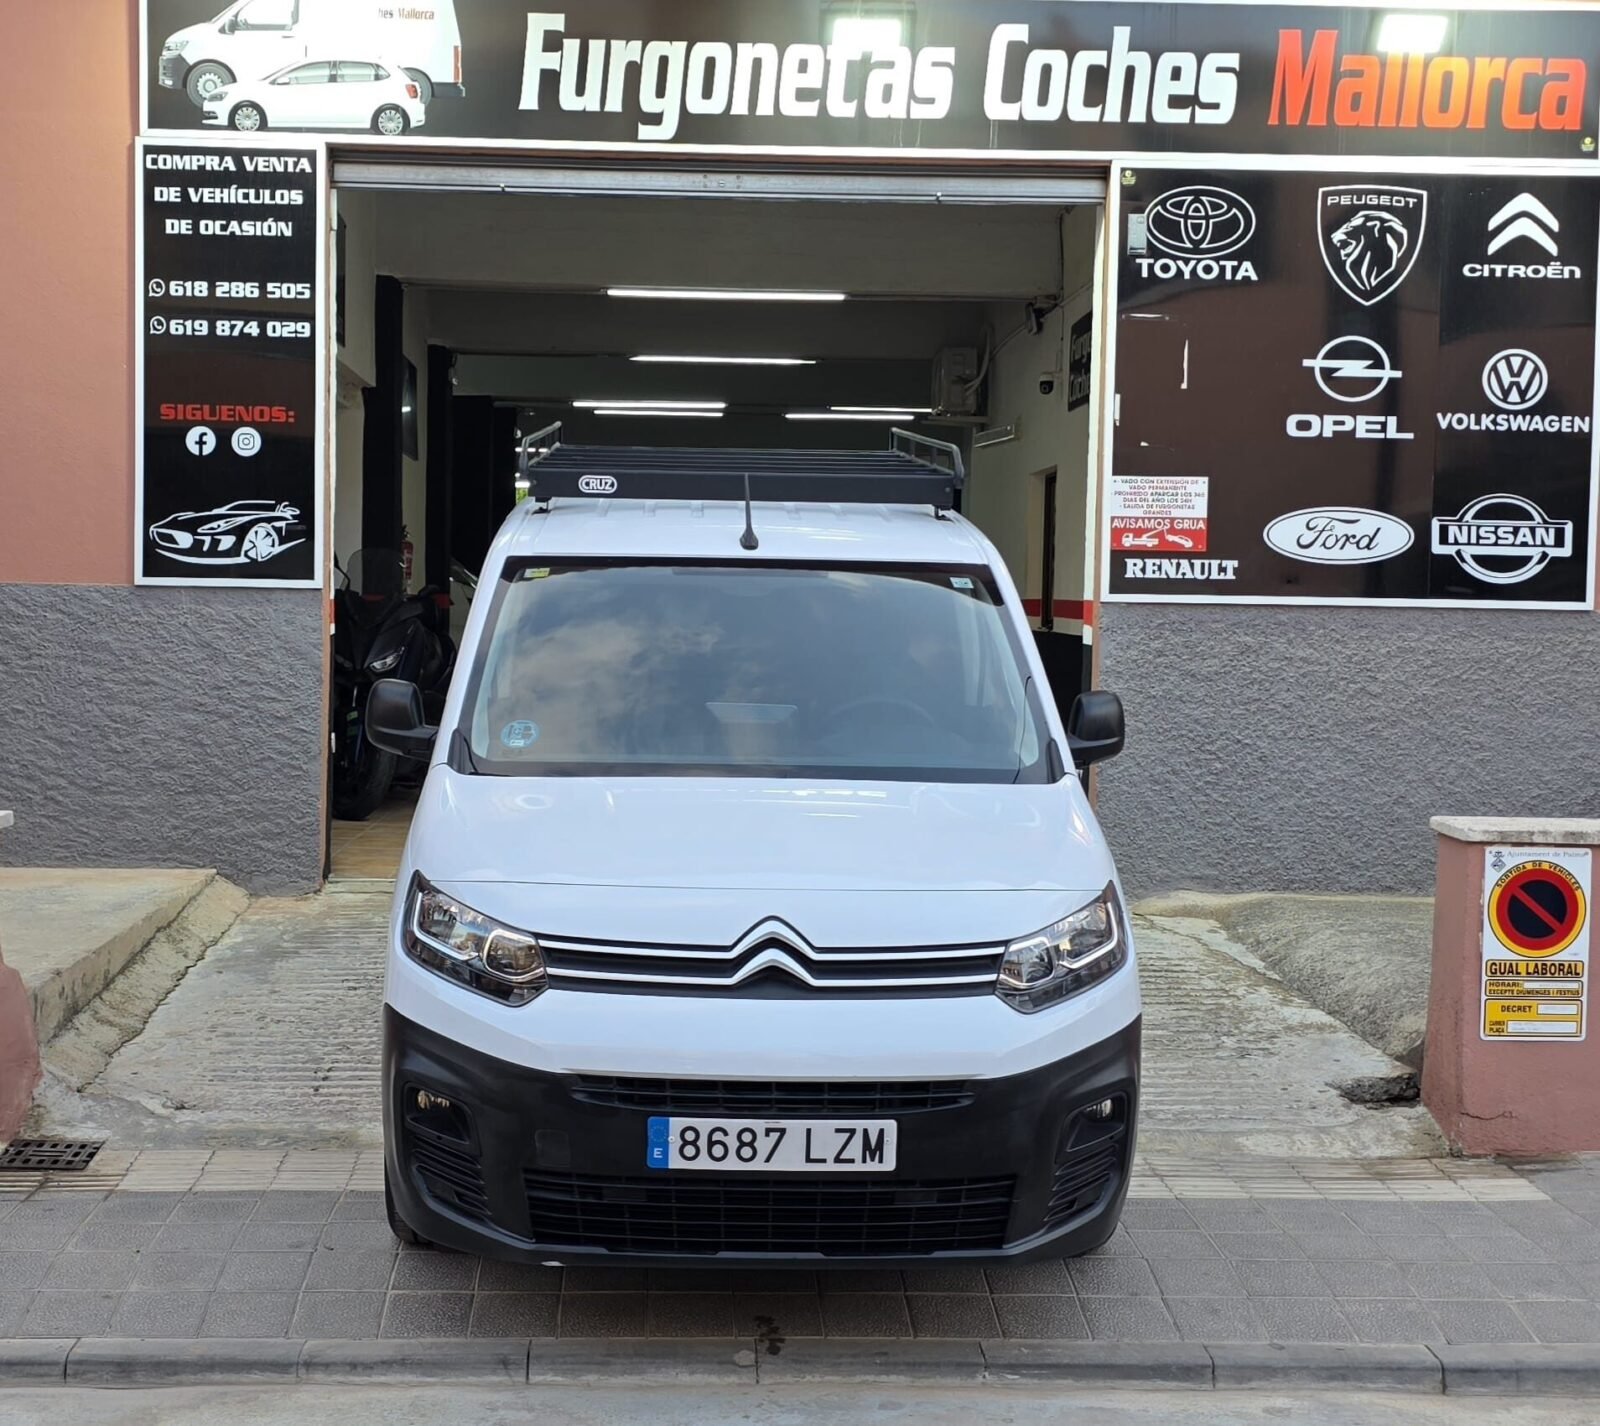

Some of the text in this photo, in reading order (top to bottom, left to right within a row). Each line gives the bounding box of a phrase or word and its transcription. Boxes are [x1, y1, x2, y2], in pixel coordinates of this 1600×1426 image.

[518, 12, 1587, 141] Furgonetas Coches Mallorca
[145, 153, 313, 173] COMPRA VENTA
[153, 184, 304, 205] DE VEHÍCULOS
[1327, 195, 1418, 208] PEUGEOT
[165, 217, 293, 237] DE OCASIÓN
[1135, 258, 1259, 281] TOYOTA
[169, 280, 311, 299] 618 286 505
[169, 319, 311, 338] 619 874 029
[160, 404, 295, 422] SIGUENOS:
[1436, 412, 1590, 433] VOLKSWAGEN
[1286, 413, 1415, 440] OPEL
[582, 478, 613, 490] CRUZ
[1112, 518, 1206, 530] AVISAMOS GRUA
[1296, 515, 1382, 551] Ford
[1448, 525, 1555, 547] NISSAN
[1124, 558, 1239, 580] RENAULT
[1496, 864, 1527, 889] SORTIDA
[1548, 863, 1581, 892] VEHICLES
[1489, 962, 1581, 977] GUAL LABORAL
[1500, 1005, 1533, 1013] DECRET
[653, 1147, 663, 1158] E
[678, 1125, 886, 1164] 8687 LZM
